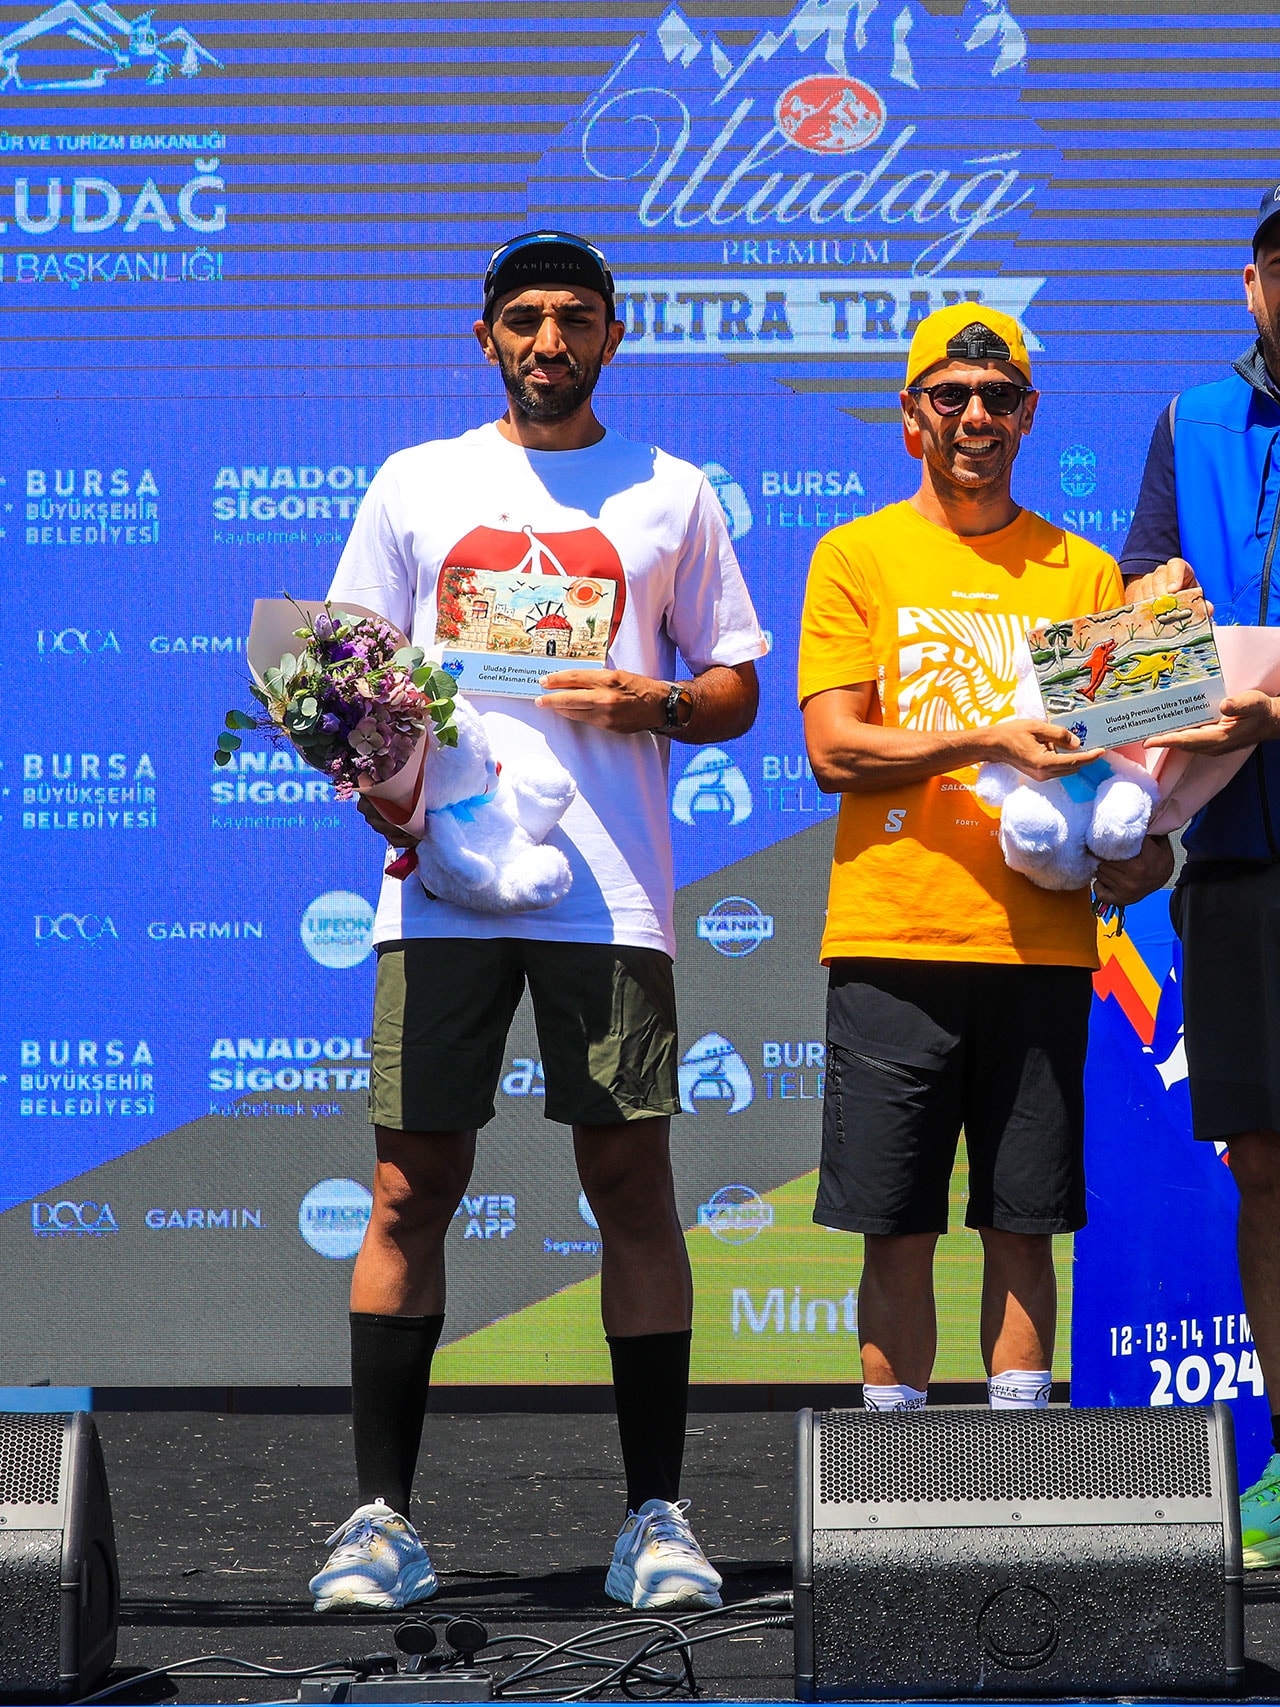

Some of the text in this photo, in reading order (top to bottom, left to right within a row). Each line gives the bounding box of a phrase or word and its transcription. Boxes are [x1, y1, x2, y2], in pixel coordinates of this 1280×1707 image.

[28, 134, 50, 150] VE
[130, 131, 226, 150] BAKANLIĞI
[0, 157, 226, 234] UDAĞ
[722, 239, 889, 264] PREMIUM
[16, 246, 223, 289] BAŞKANLIĞI
[619, 291, 982, 340] ULTRA TRA
[26, 469, 159, 497] BURSA
[213, 466, 378, 490] ANADOL
[763, 470, 867, 496] BURSA
[213, 490, 362, 520] SİGORT
[26, 520, 159, 545] BELEDİYESİ
[150, 635, 249, 654] GARMI
[478, 673, 498, 681] Genel
[498, 675, 526, 683] Klasman
[507, 667, 537, 675] Premium
[1105, 693, 1207, 725] Uludağ Premium Ultra Trail 66K
[1107, 722, 1128, 734] Genel
[1128, 716, 1156, 729] Klasman
[1156, 710, 1184, 722] Erkekler
[1184, 702, 1211, 715] Birincisi
[23, 752, 156, 780] BURSA
[23, 803, 157, 830] BELEDİYESİ
[884, 809, 907, 832] S
[955, 819, 980, 827] FORTY
[20, 1039, 154, 1068] BURSA
[210, 1036, 371, 1060] ANADOL
[762, 1041, 826, 1068] BUR
[20, 1093, 155, 1117] BELEDİYESİ
[453, 1194, 516, 1218] WER
[463, 1218, 516, 1239] APP
[1213, 1313, 1256, 1344] TEM
[1150, 1349, 1265, 1406] 2024
